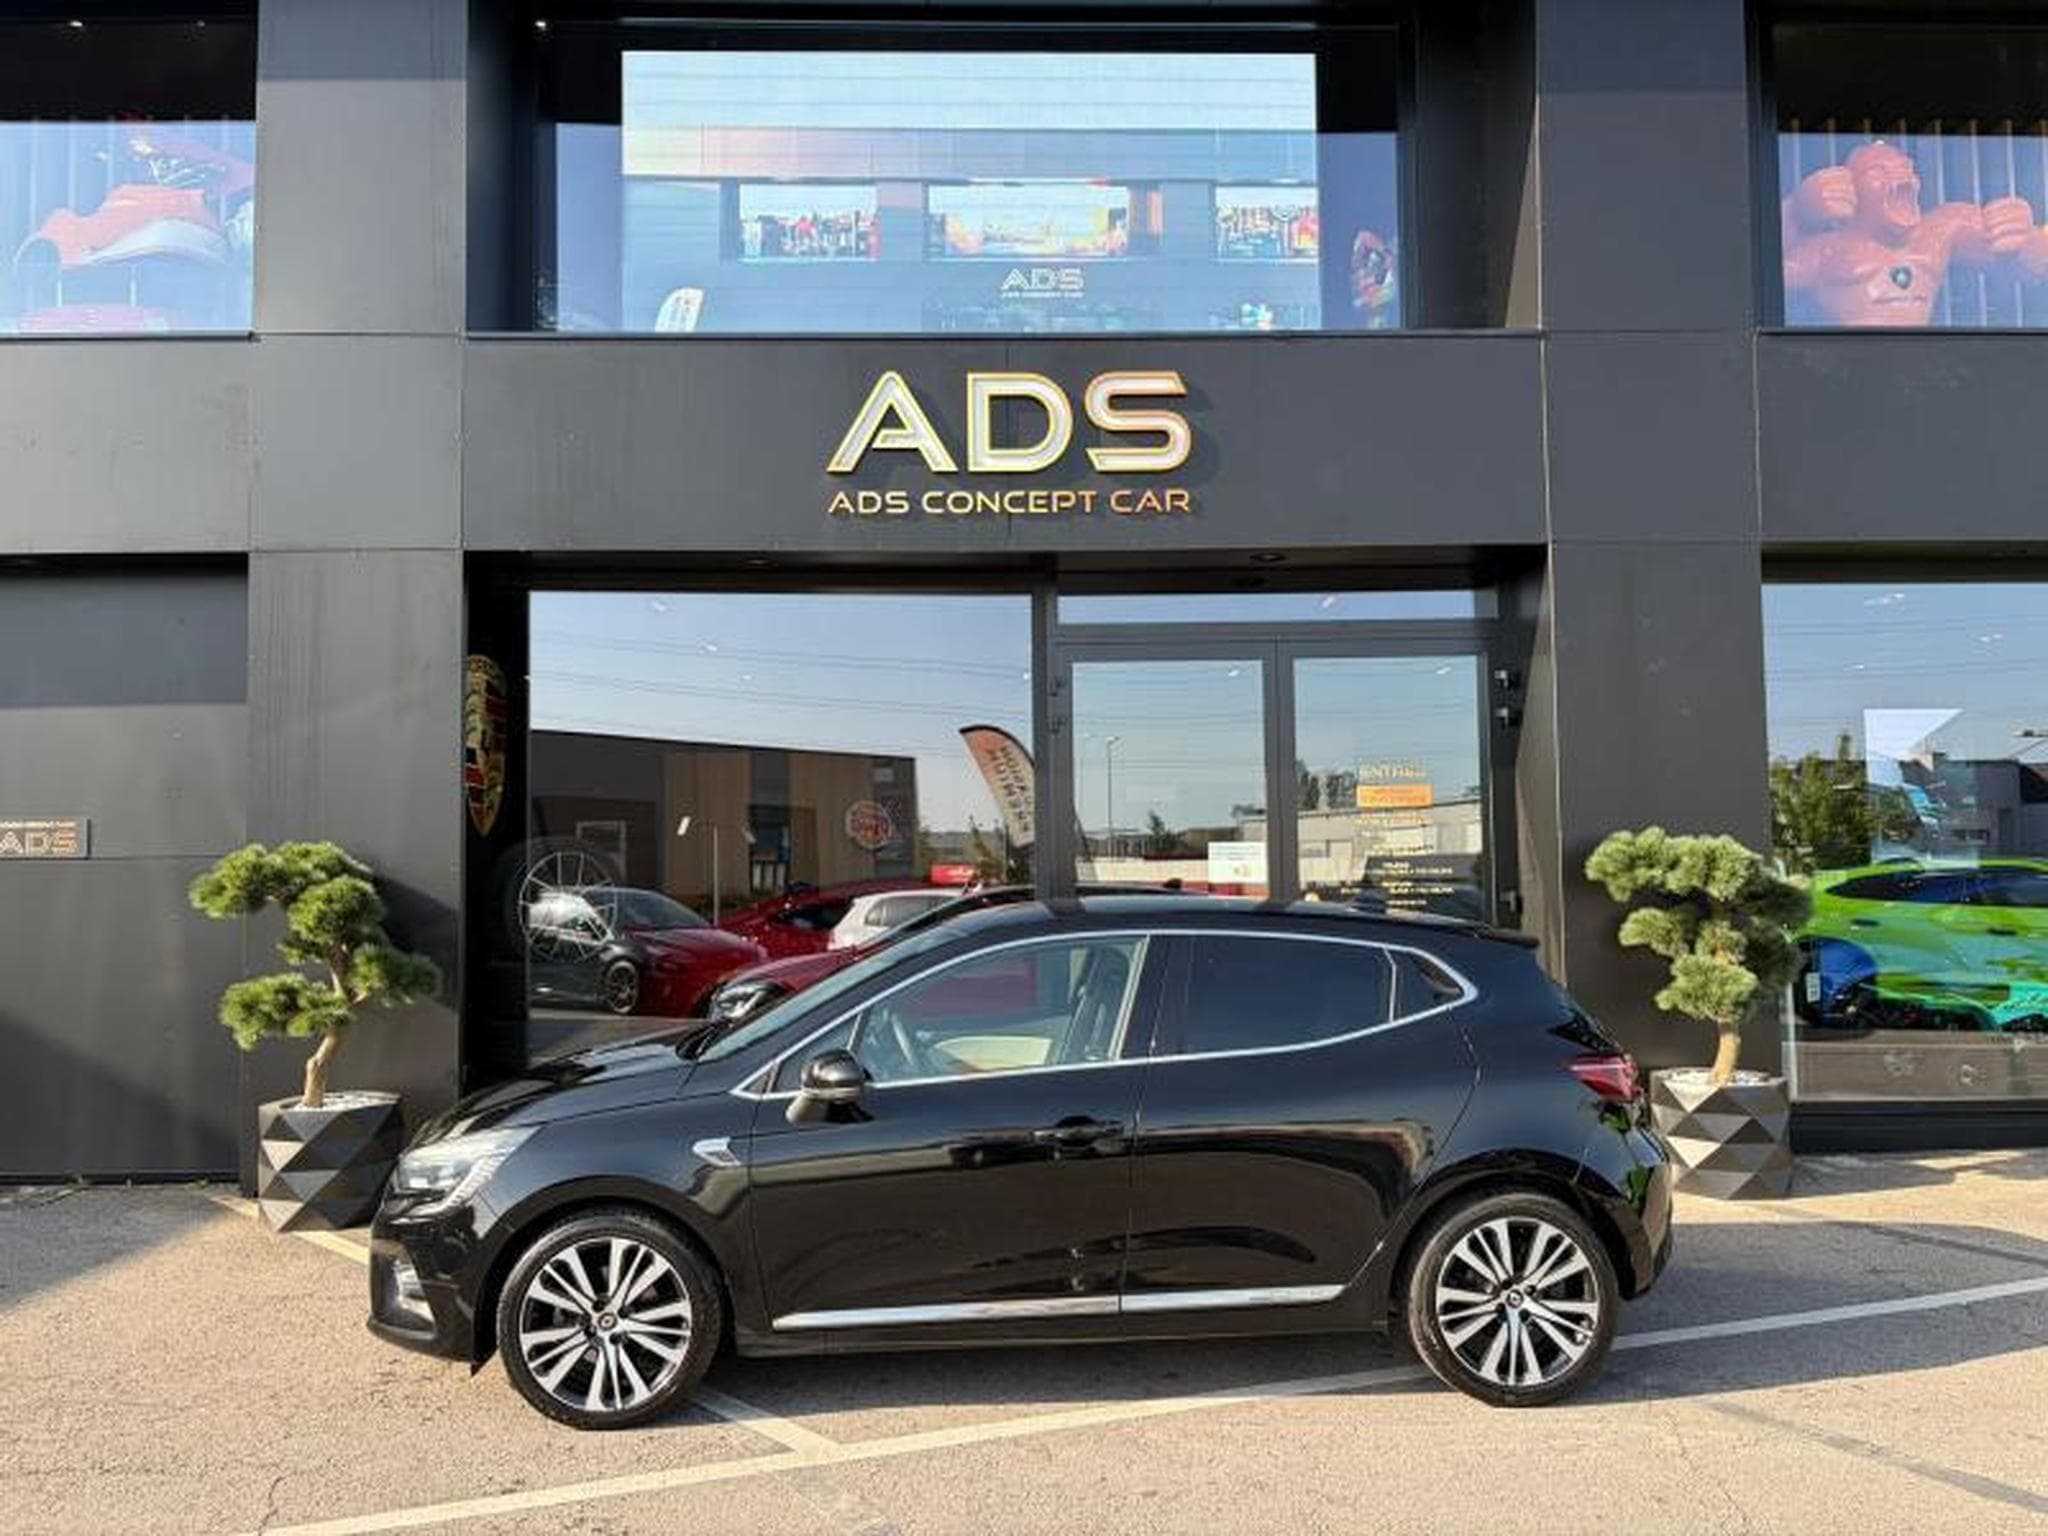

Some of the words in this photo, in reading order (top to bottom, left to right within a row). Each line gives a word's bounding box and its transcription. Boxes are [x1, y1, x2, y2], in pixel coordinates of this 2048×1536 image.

[1001, 268, 1085, 291] ADS
[826, 370, 1192, 473] ADS
[828, 490, 909, 514] ADS
[921, 489, 1097, 514] CONCEPT
[1109, 488, 1190, 513] CAR
[0, 831, 78, 855] ADS
